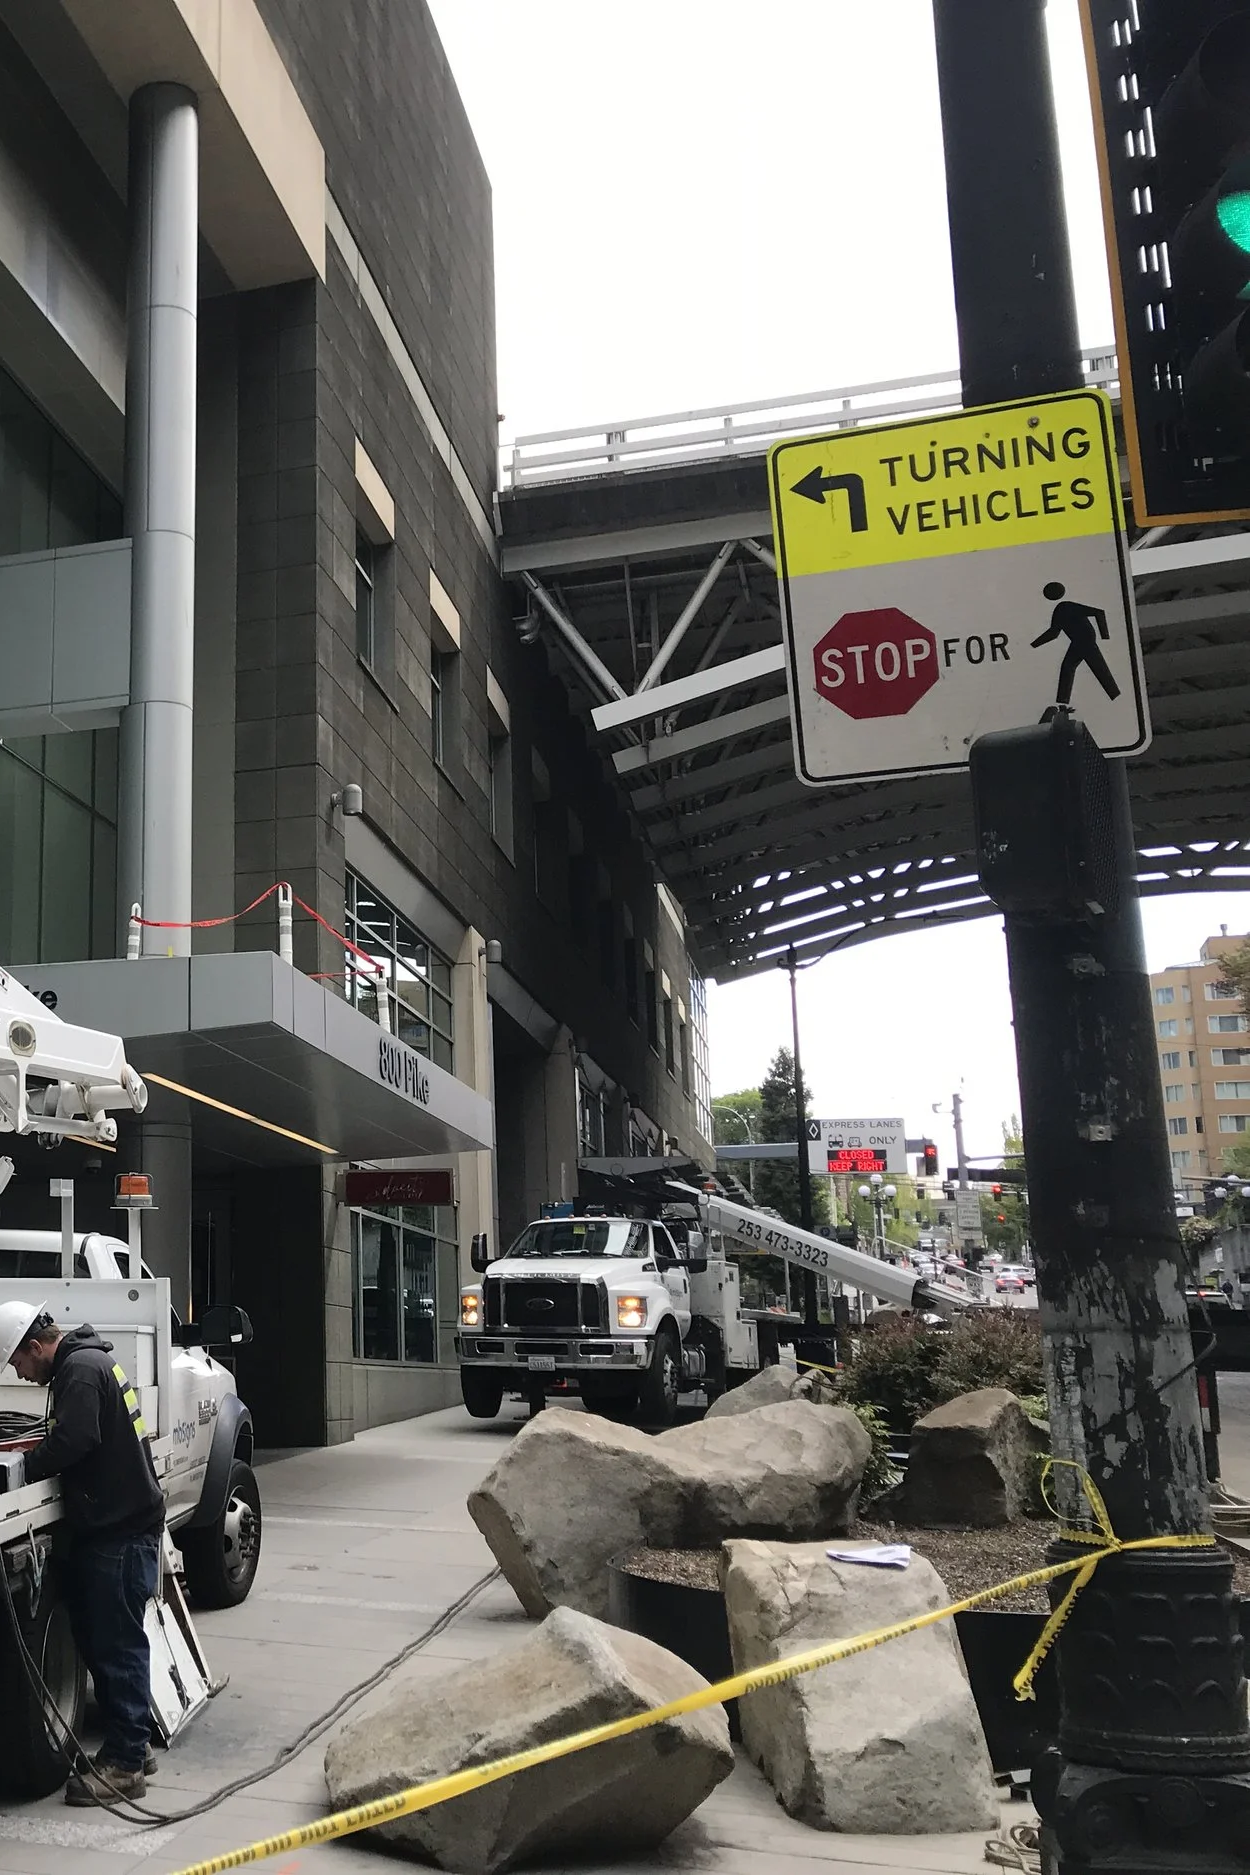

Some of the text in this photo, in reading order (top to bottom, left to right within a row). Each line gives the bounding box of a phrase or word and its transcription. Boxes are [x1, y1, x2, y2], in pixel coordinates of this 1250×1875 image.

[879, 427, 1091, 487] TURNING
[886, 477, 1095, 535] VEHICLES
[821, 638, 932, 688] STOP
[943, 633, 1010, 667] FOR
[379, 1037, 430, 1105] 800 Pike
[822, 1120, 902, 1129] EXPRESS LANES
[869, 1136, 897, 1145] ONLY
[829, 1161, 884, 1171] KEEP RIGHT
[838, 1150, 874, 1160] CLOSED
[737, 1218, 829, 1267] 253 473-3323
